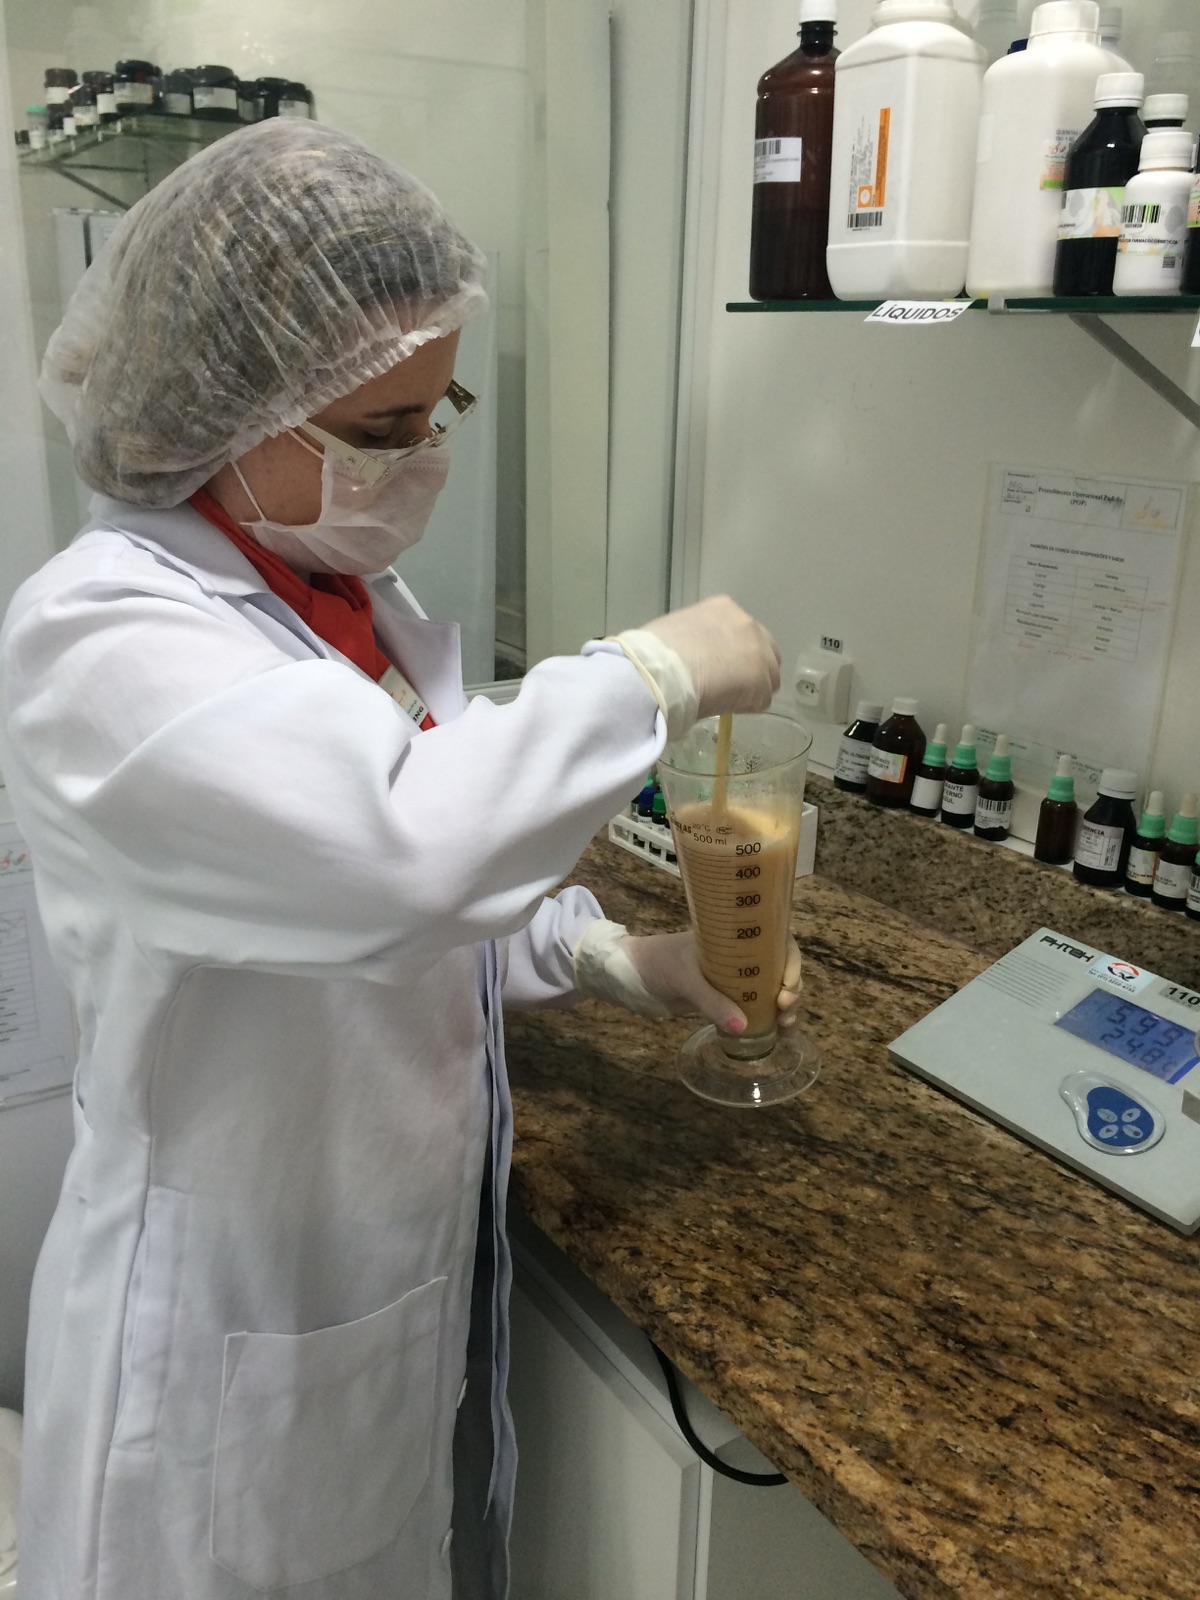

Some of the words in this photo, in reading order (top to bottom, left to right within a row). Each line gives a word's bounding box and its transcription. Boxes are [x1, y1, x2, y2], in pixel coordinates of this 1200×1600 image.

[871, 303, 964, 320] LÍQUIDOS
[823, 637, 840, 649] 110
[693, 833, 713, 844] 500
[715, 837, 727, 845] ml
[735, 842, 762, 856] 500
[735, 866, 761, 879] 400
[735, 894, 761, 907] 300
[736, 926, 761, 939] 200
[737, 966, 760, 977] 100
[742, 991, 758, 1002] 50
[1168, 986, 1200, 1006] 110
